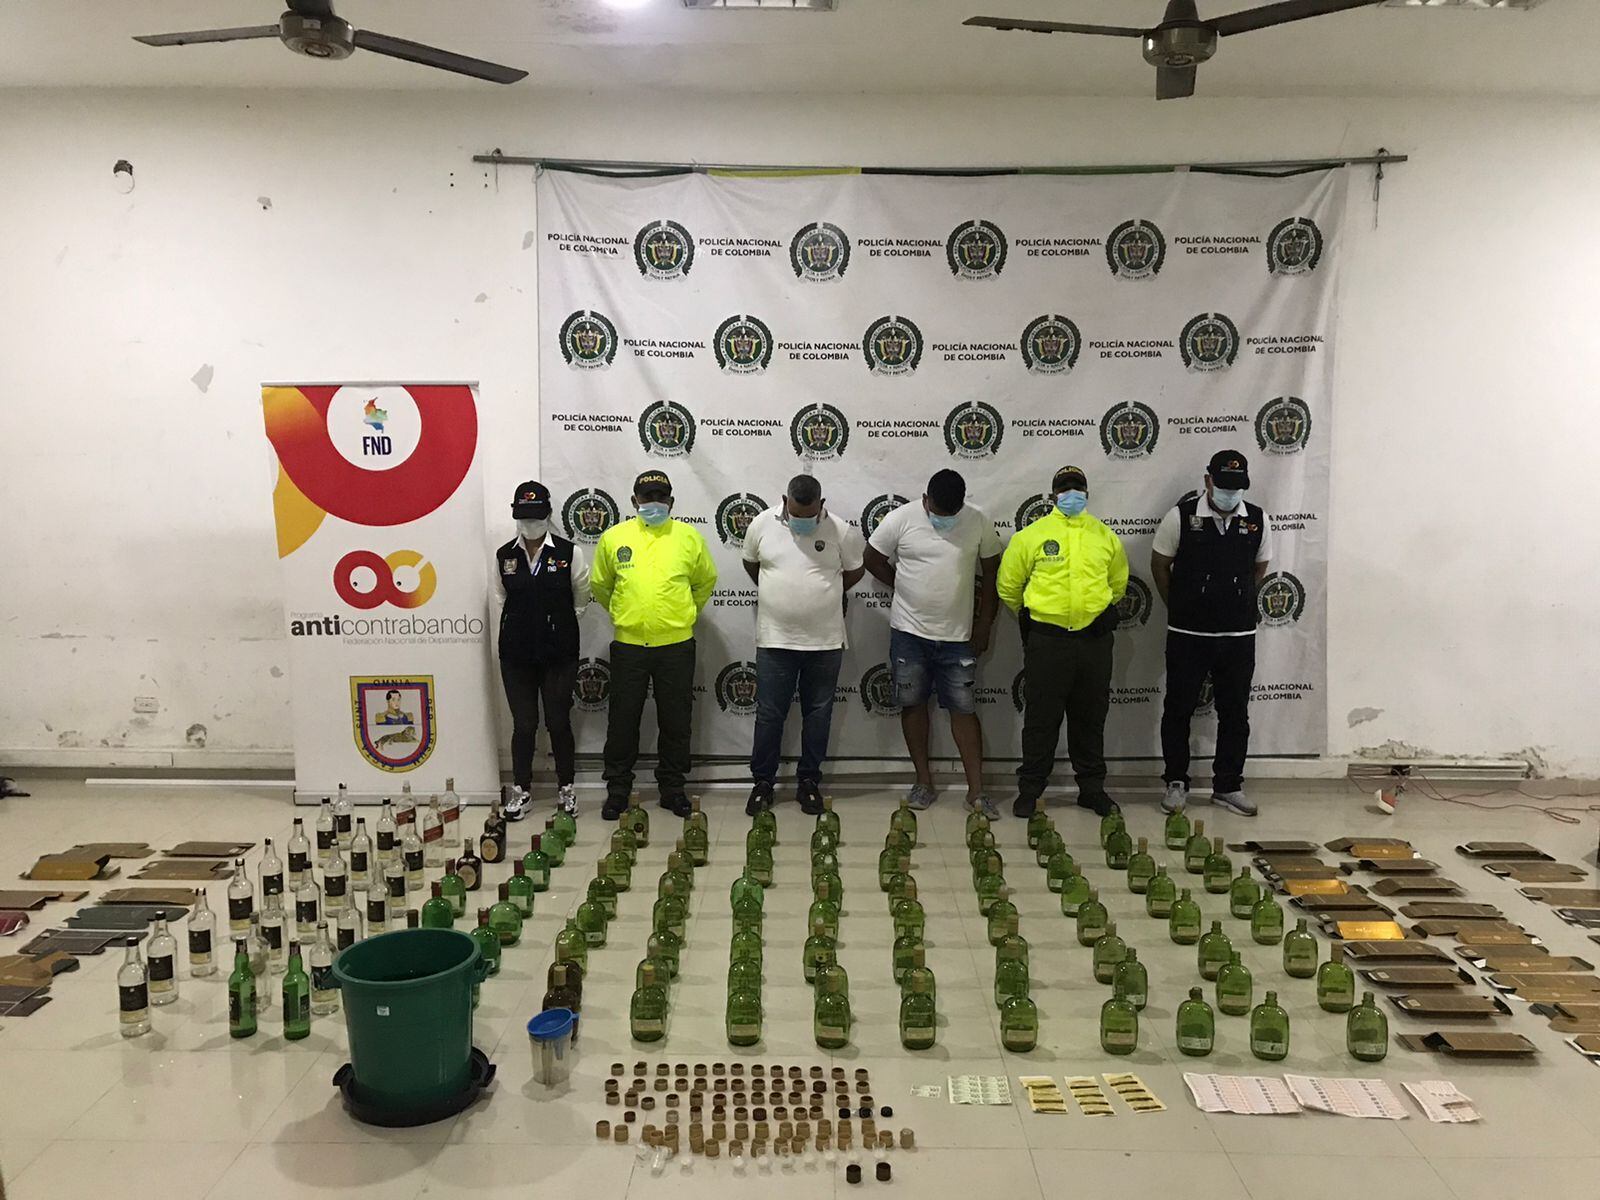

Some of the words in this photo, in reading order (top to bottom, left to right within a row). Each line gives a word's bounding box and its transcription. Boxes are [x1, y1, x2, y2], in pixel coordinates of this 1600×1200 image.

[583, 236, 629, 244] NACIONAL
[573, 244, 618, 254] COLOMBIA
[814, 342, 861, 351] NACIONAL
[363, 436, 392, 455] FND
[1271, 523, 1305, 531] OLOMBIA
[291, 614, 483, 636] anticontrabando
